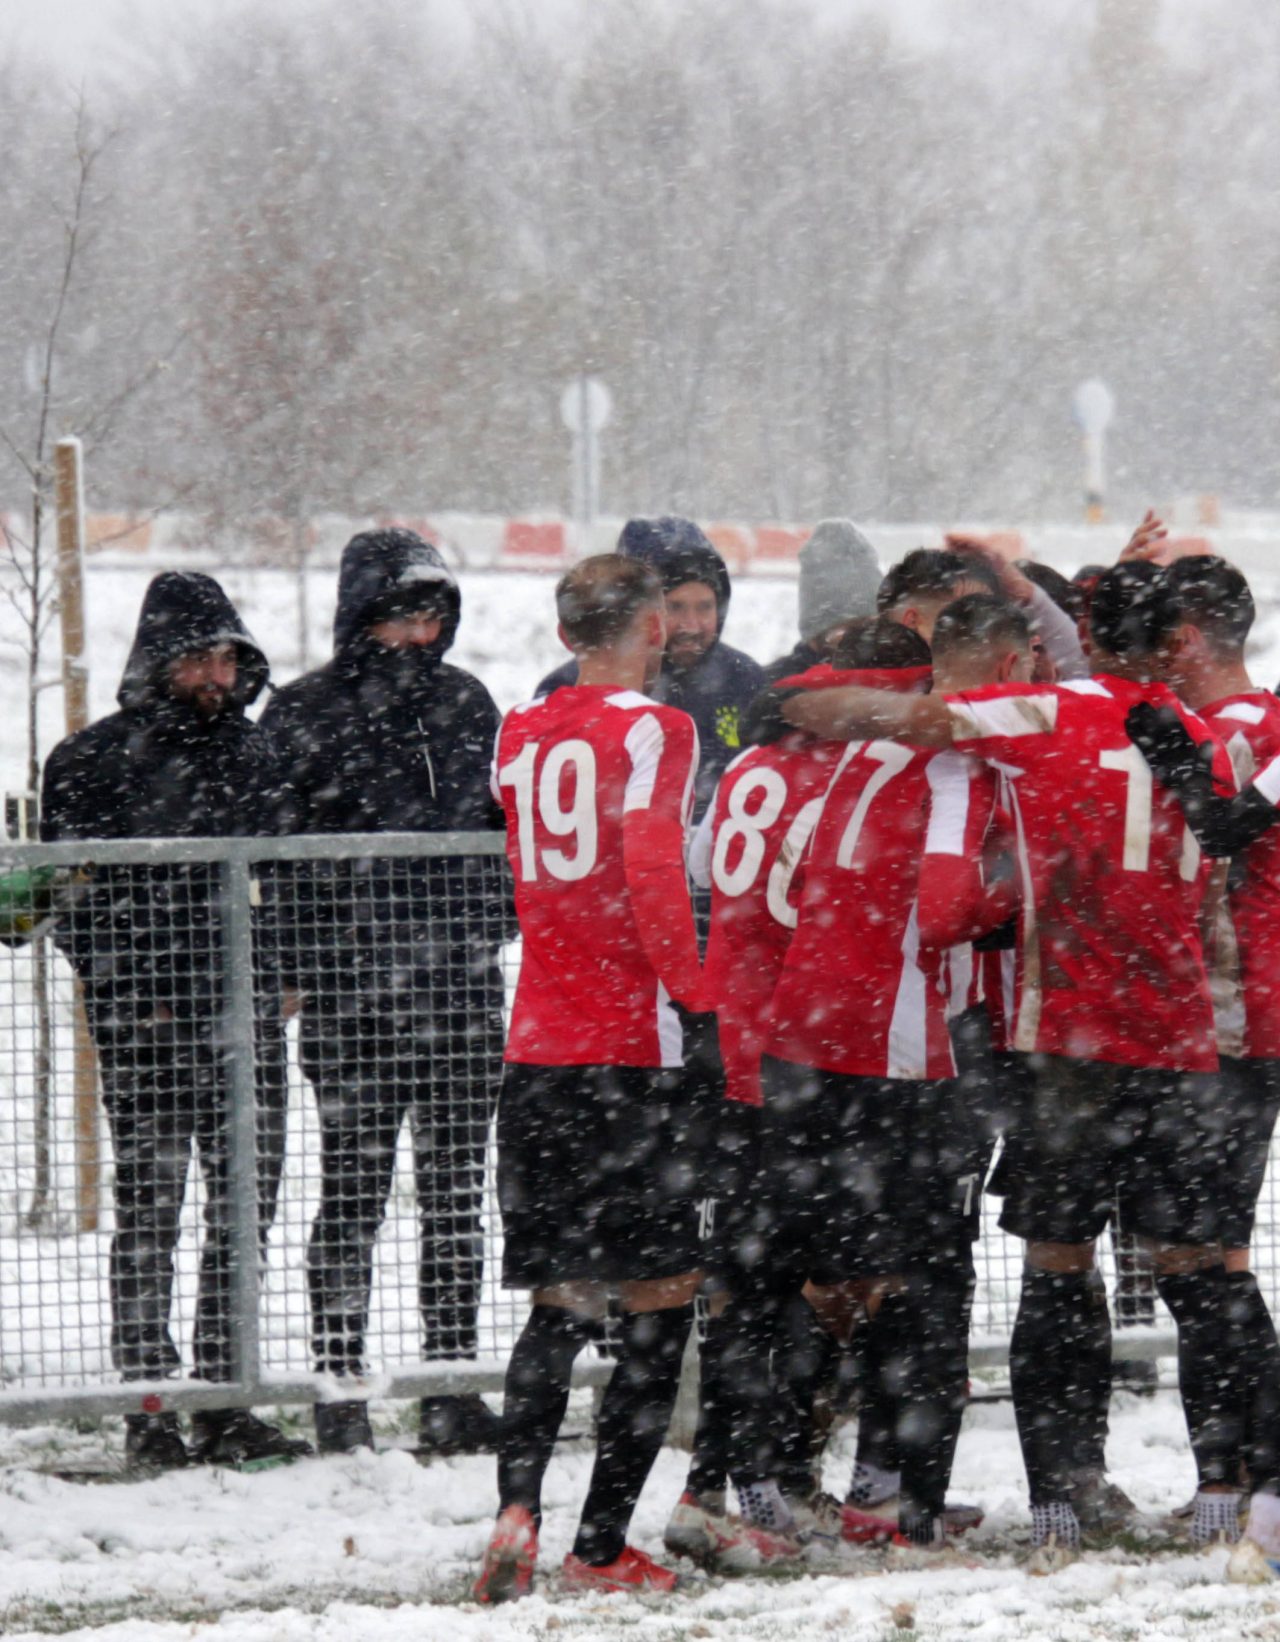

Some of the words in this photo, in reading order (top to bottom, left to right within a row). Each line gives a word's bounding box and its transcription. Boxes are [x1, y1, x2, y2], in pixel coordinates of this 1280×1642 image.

[499, 738, 598, 882] 19
[839, 739, 916, 870] 7
[1099, 743, 1201, 882] 1
[957, 1172, 979, 1217] 7
